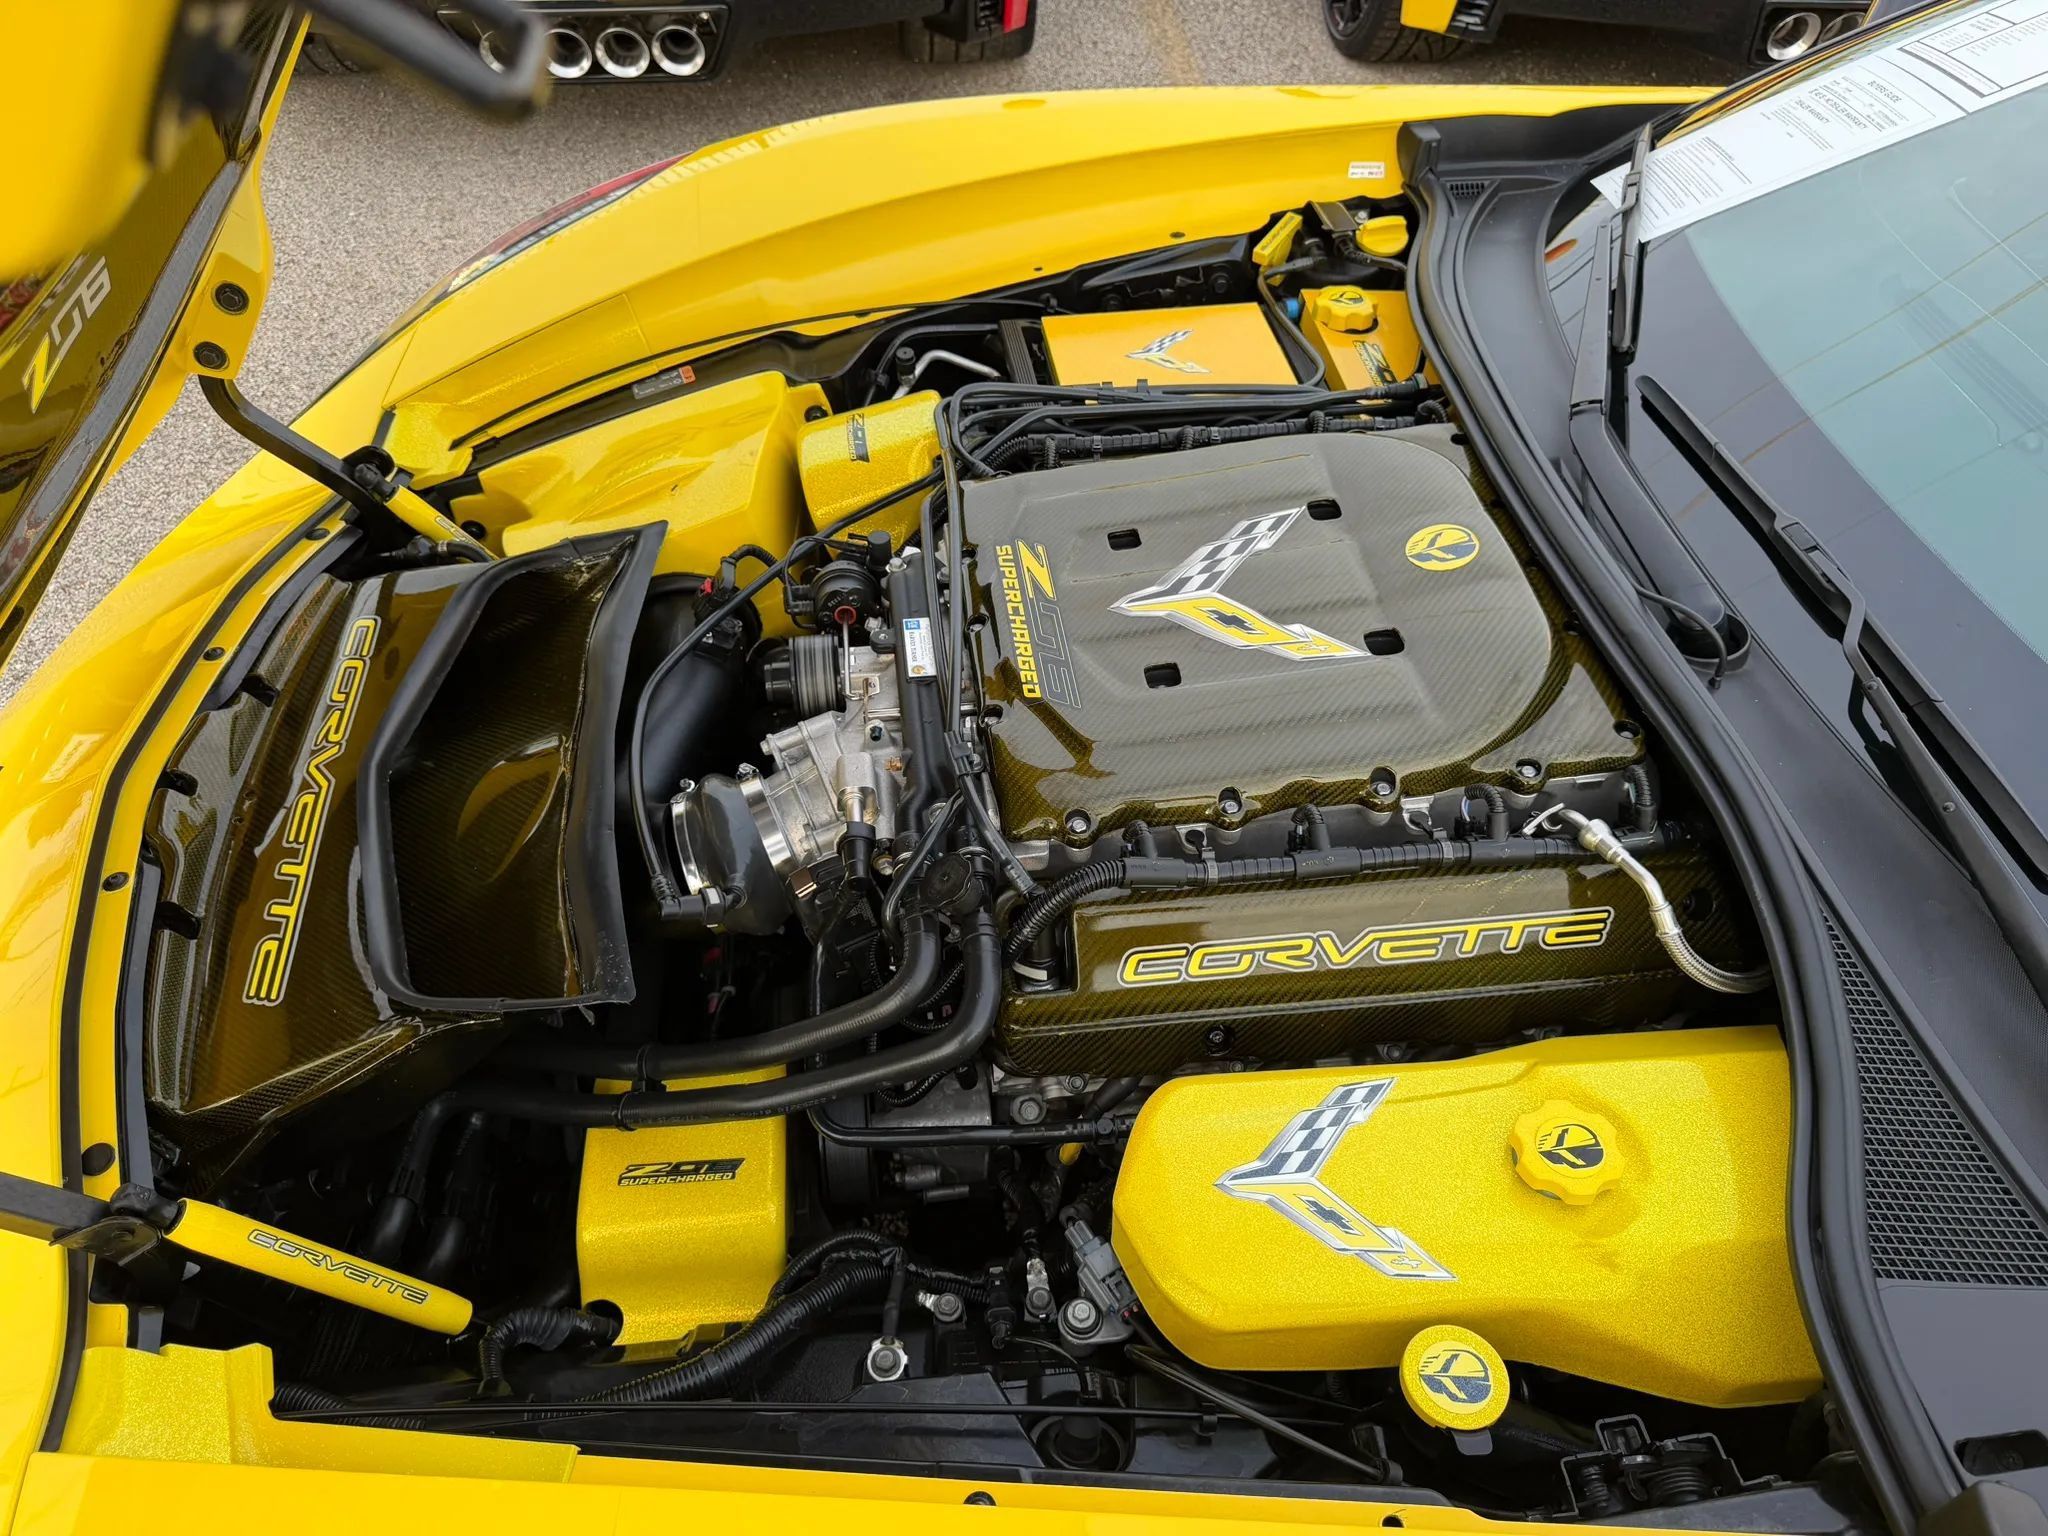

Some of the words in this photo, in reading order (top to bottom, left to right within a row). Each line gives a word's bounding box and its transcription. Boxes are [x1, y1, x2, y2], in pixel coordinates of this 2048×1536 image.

[22, 255, 112, 414] Z06
[996, 545, 1043, 699] SUPERCHARGED
[242, 615, 381, 1007] CORVETTE
[1117, 906, 1614, 988] CORVETTE
[618, 1172, 736, 1187] SUPERCHARGED
[248, 1228, 428, 1305] CORVETTE
